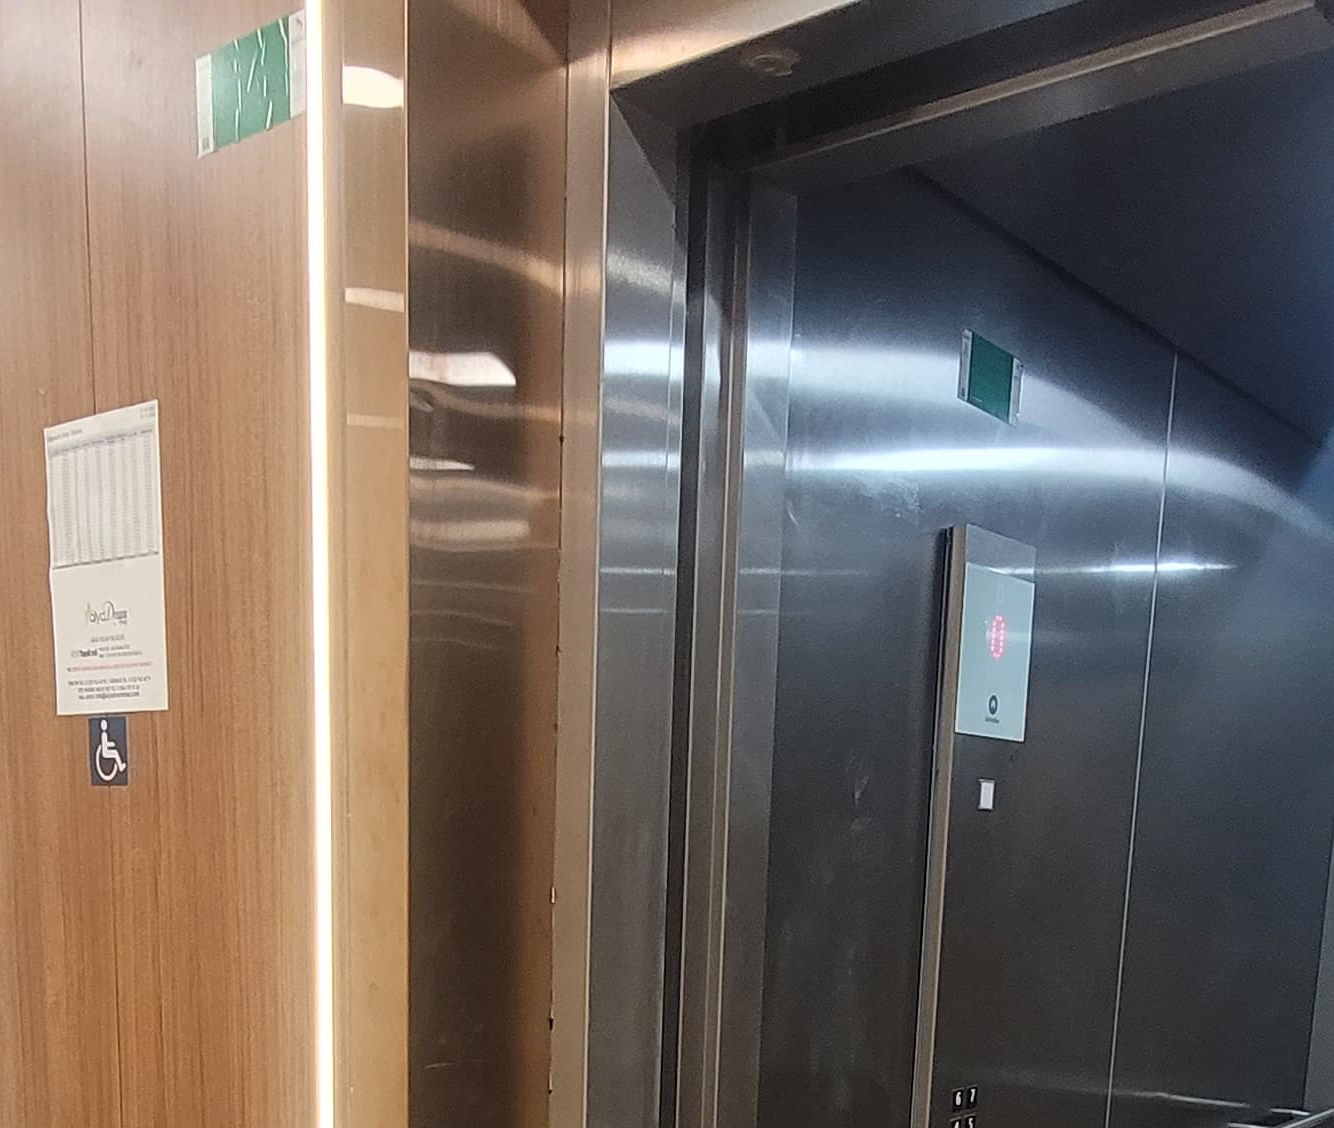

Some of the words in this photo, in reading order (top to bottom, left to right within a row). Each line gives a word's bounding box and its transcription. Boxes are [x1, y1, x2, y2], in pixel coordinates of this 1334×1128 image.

[990, 614, 1005, 659] 0
[955, 1091, 962, 1106] 6
[970, 1088, 976, 1103] 7
